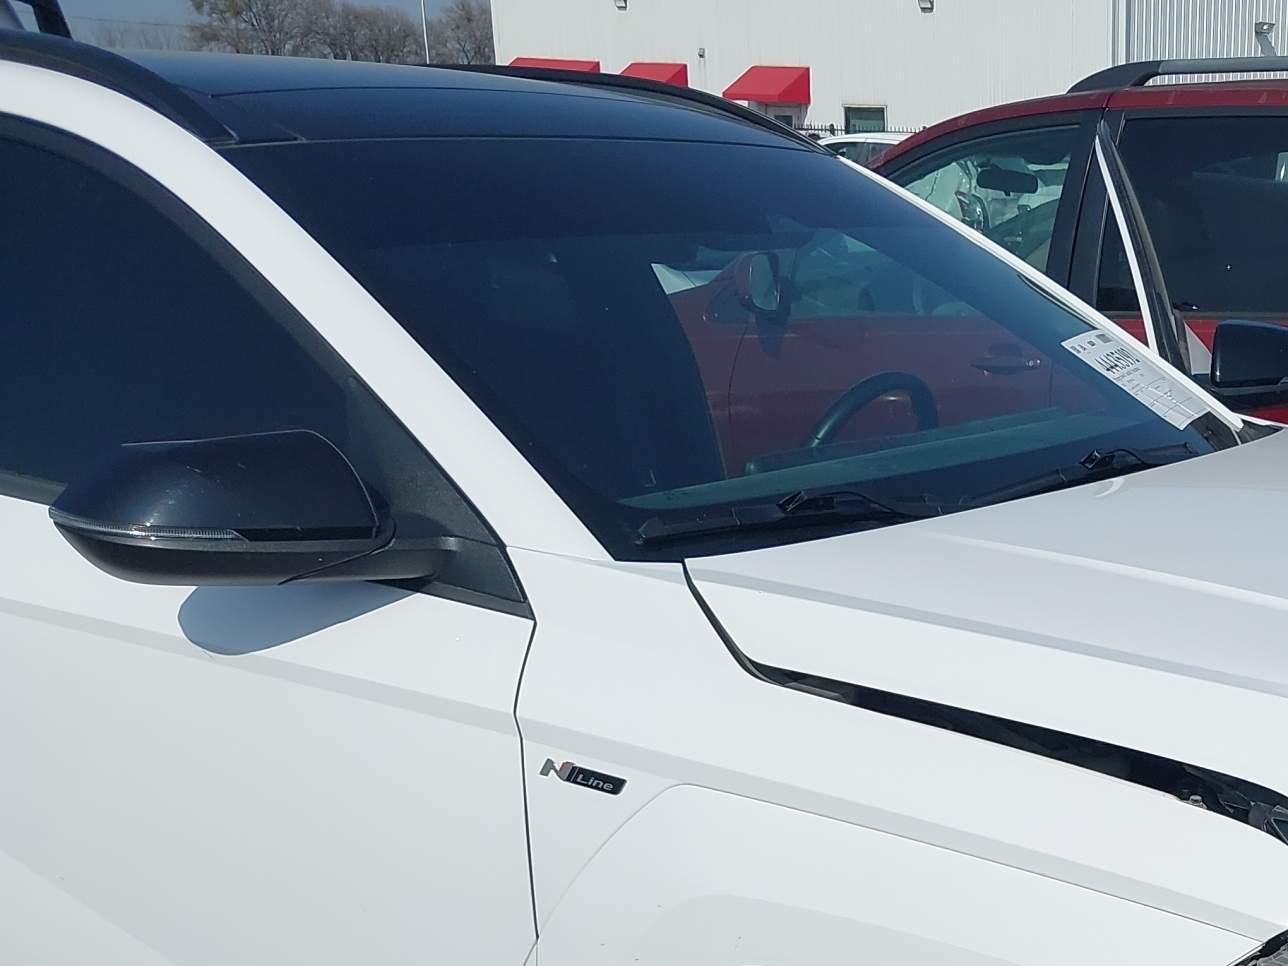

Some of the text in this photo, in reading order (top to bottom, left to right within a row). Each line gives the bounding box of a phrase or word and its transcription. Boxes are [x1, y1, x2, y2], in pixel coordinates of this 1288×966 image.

[1094, 347, 1141, 374] 44435192
[540, 758, 614, 791] N Line
